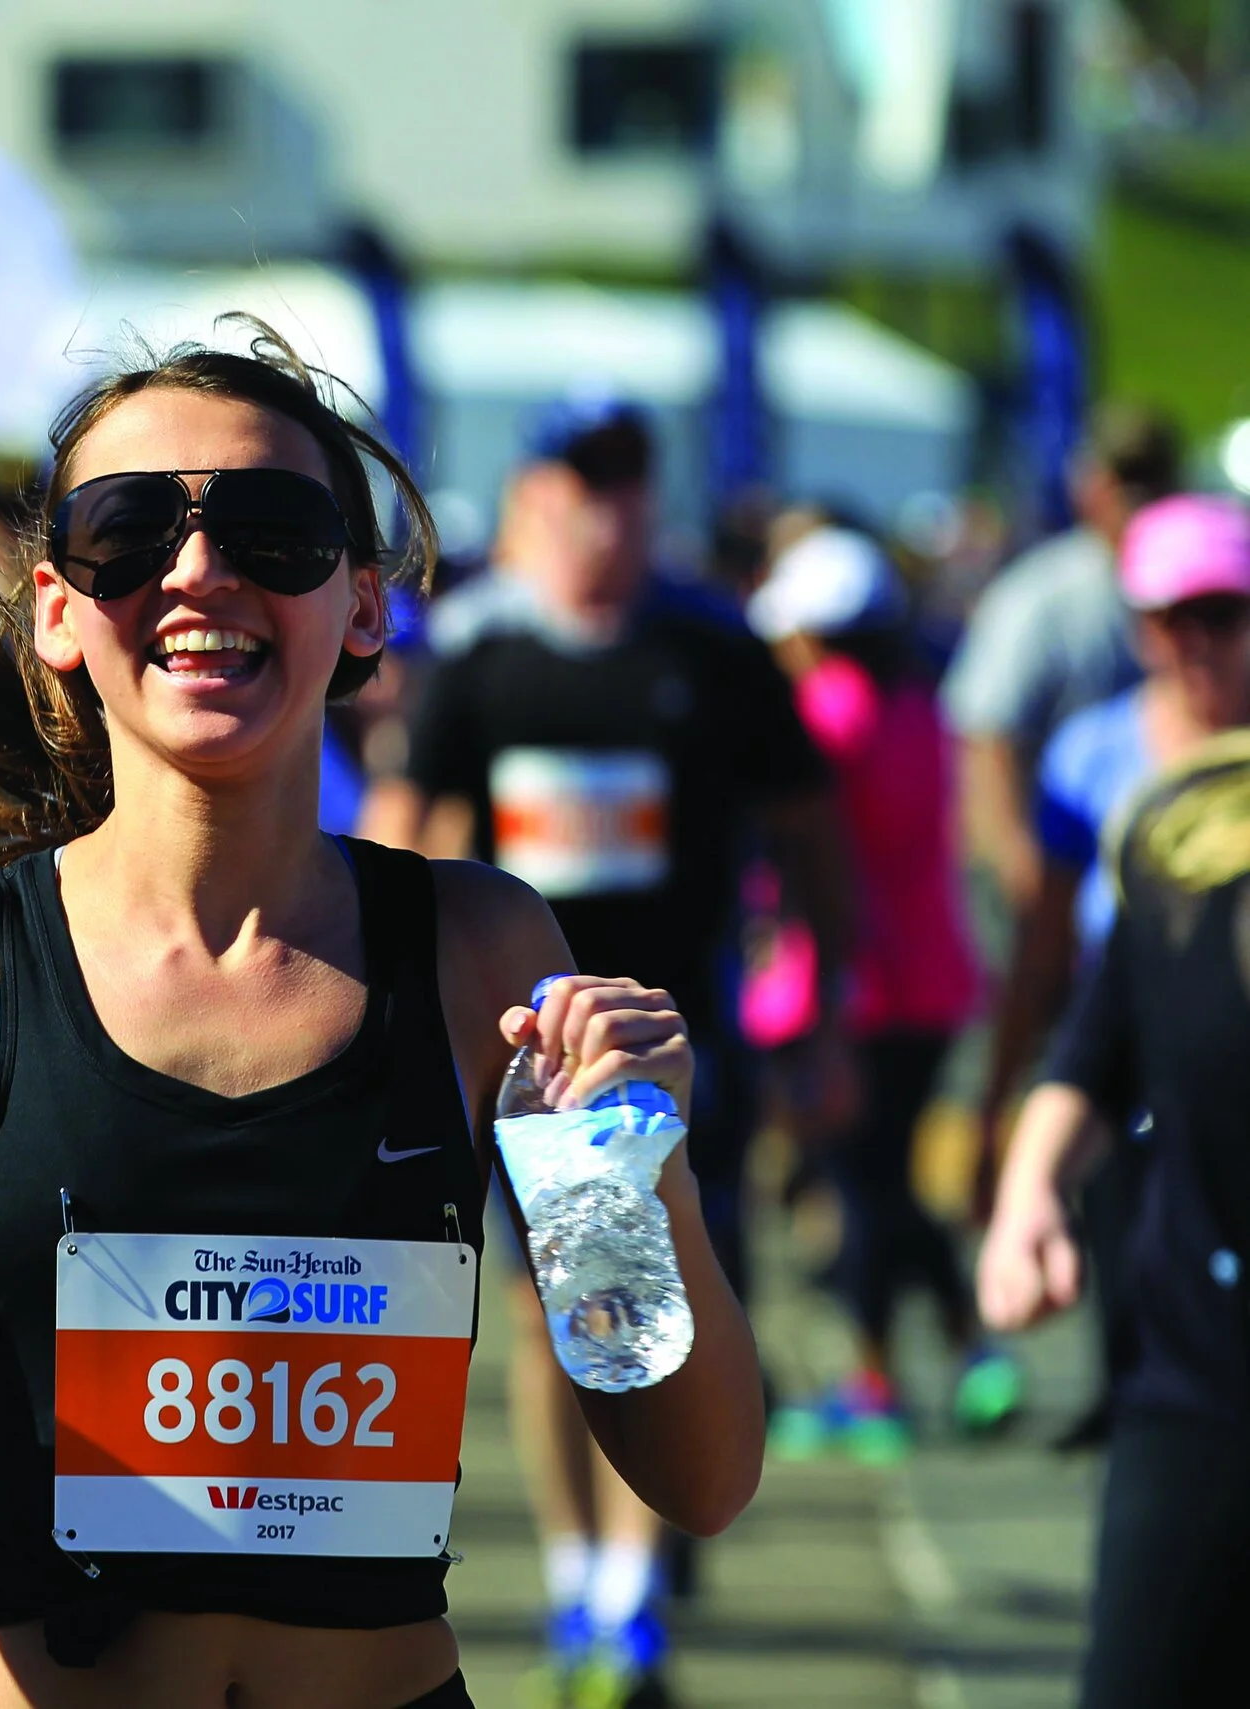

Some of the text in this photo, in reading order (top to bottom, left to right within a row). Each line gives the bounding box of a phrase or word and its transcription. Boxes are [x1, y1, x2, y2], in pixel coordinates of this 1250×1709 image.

[195, 1249, 362, 1278] The Sun-Herald
[164, 1277, 388, 1324] CITY2SURF
[143, 1357, 397, 1447] 88162
[207, 1486, 344, 1515] Westpac
[256, 1525, 296, 1540] 2017
